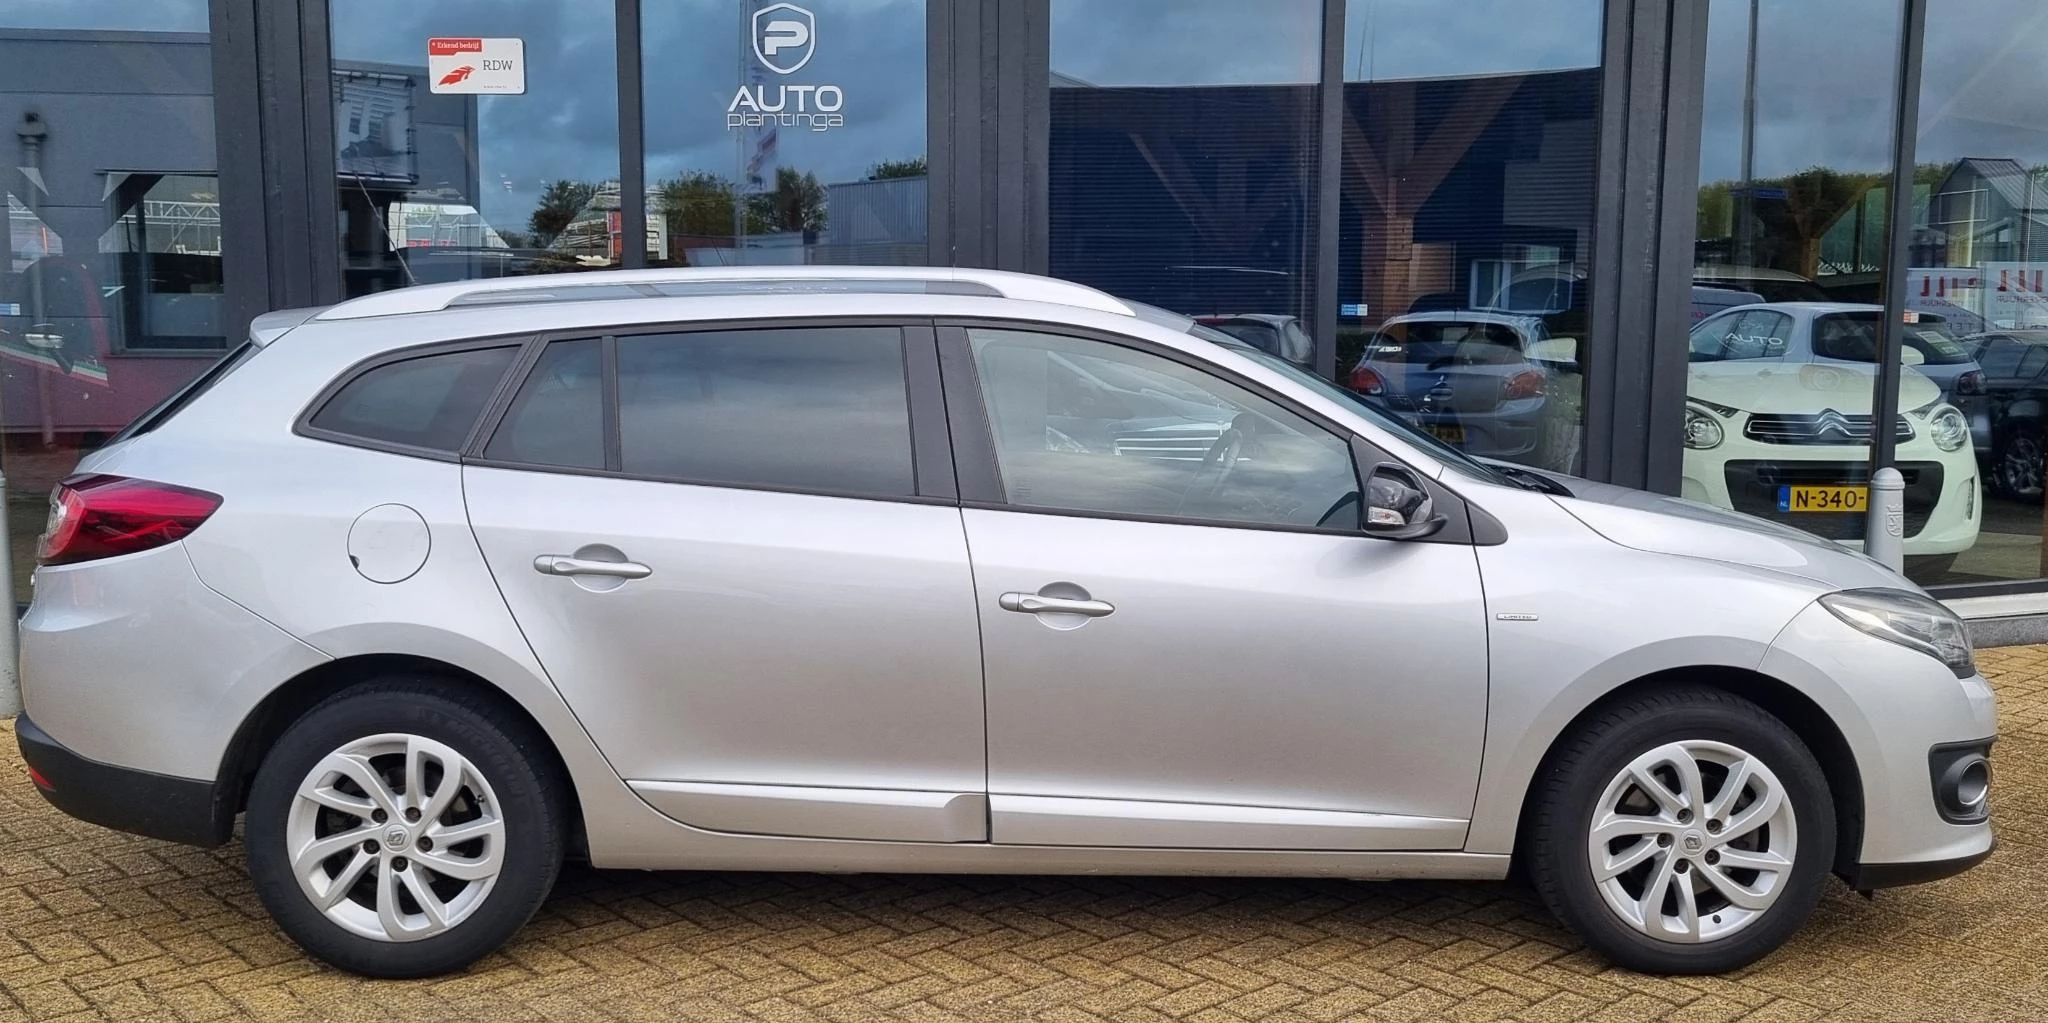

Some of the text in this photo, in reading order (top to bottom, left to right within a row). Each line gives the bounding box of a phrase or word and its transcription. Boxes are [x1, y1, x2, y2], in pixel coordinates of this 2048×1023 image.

[437, 41, 480, 50] Erkend bedrijf
[764, 20, 809, 55] P
[483, 60, 513, 71] RDW
[728, 85, 844, 112] AUTO
[727, 111, 844, 132] plantinga
[1725, 332, 1783, 346] AUTO
[1796, 490, 1865, 508] N-340-
